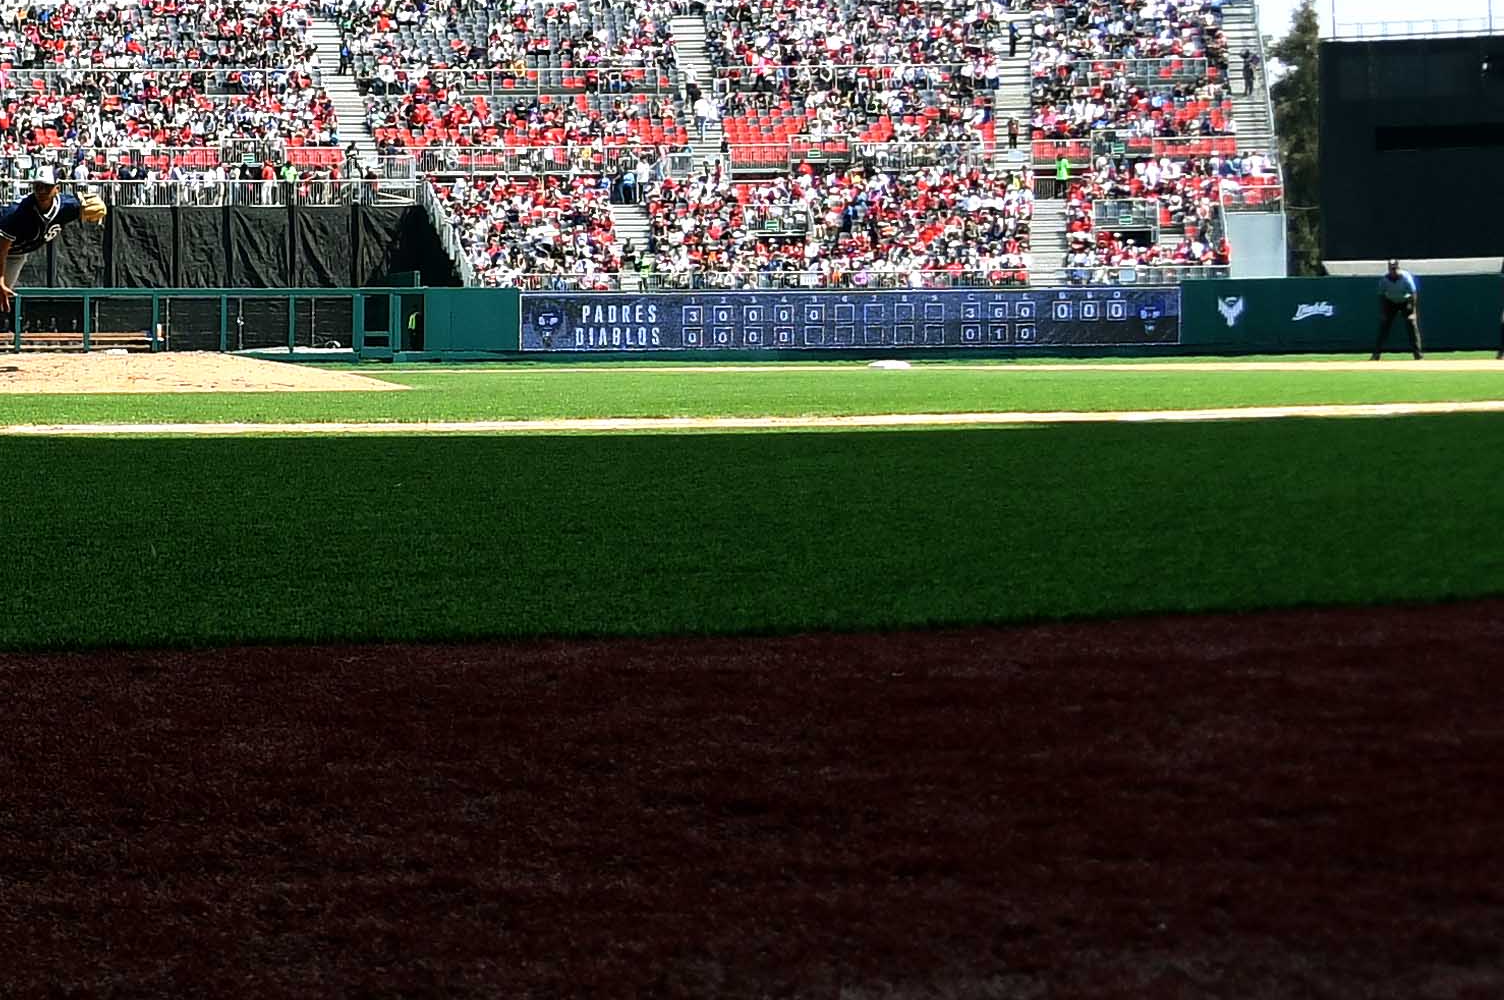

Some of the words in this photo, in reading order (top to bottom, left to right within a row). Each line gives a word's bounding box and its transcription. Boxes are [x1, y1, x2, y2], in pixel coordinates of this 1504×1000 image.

[582, 304, 657, 324] PADRES
[689, 311, 698, 323] 3
[718, 310, 728, 322] 0
[748, 310, 758, 322] 0
[779, 310, 788, 321] 0
[809, 310, 819, 321] 0
[965, 307, 976, 319] 3
[1020, 307, 1030, 318] 0
[1057, 304, 1068, 319] 0
[1083, 303, 1095, 318] 0
[1111, 303, 1122, 318] 0
[575, 327, 660, 346] DIABLOS
[688, 332, 697, 343] 0
[718, 332, 728, 343] 0
[748, 331, 758, 342] 0
[779, 331, 788, 342] 0
[965, 328, 975, 340] 0
[995, 328, 1003, 340] 1
[1020, 328, 1030, 339] 0
